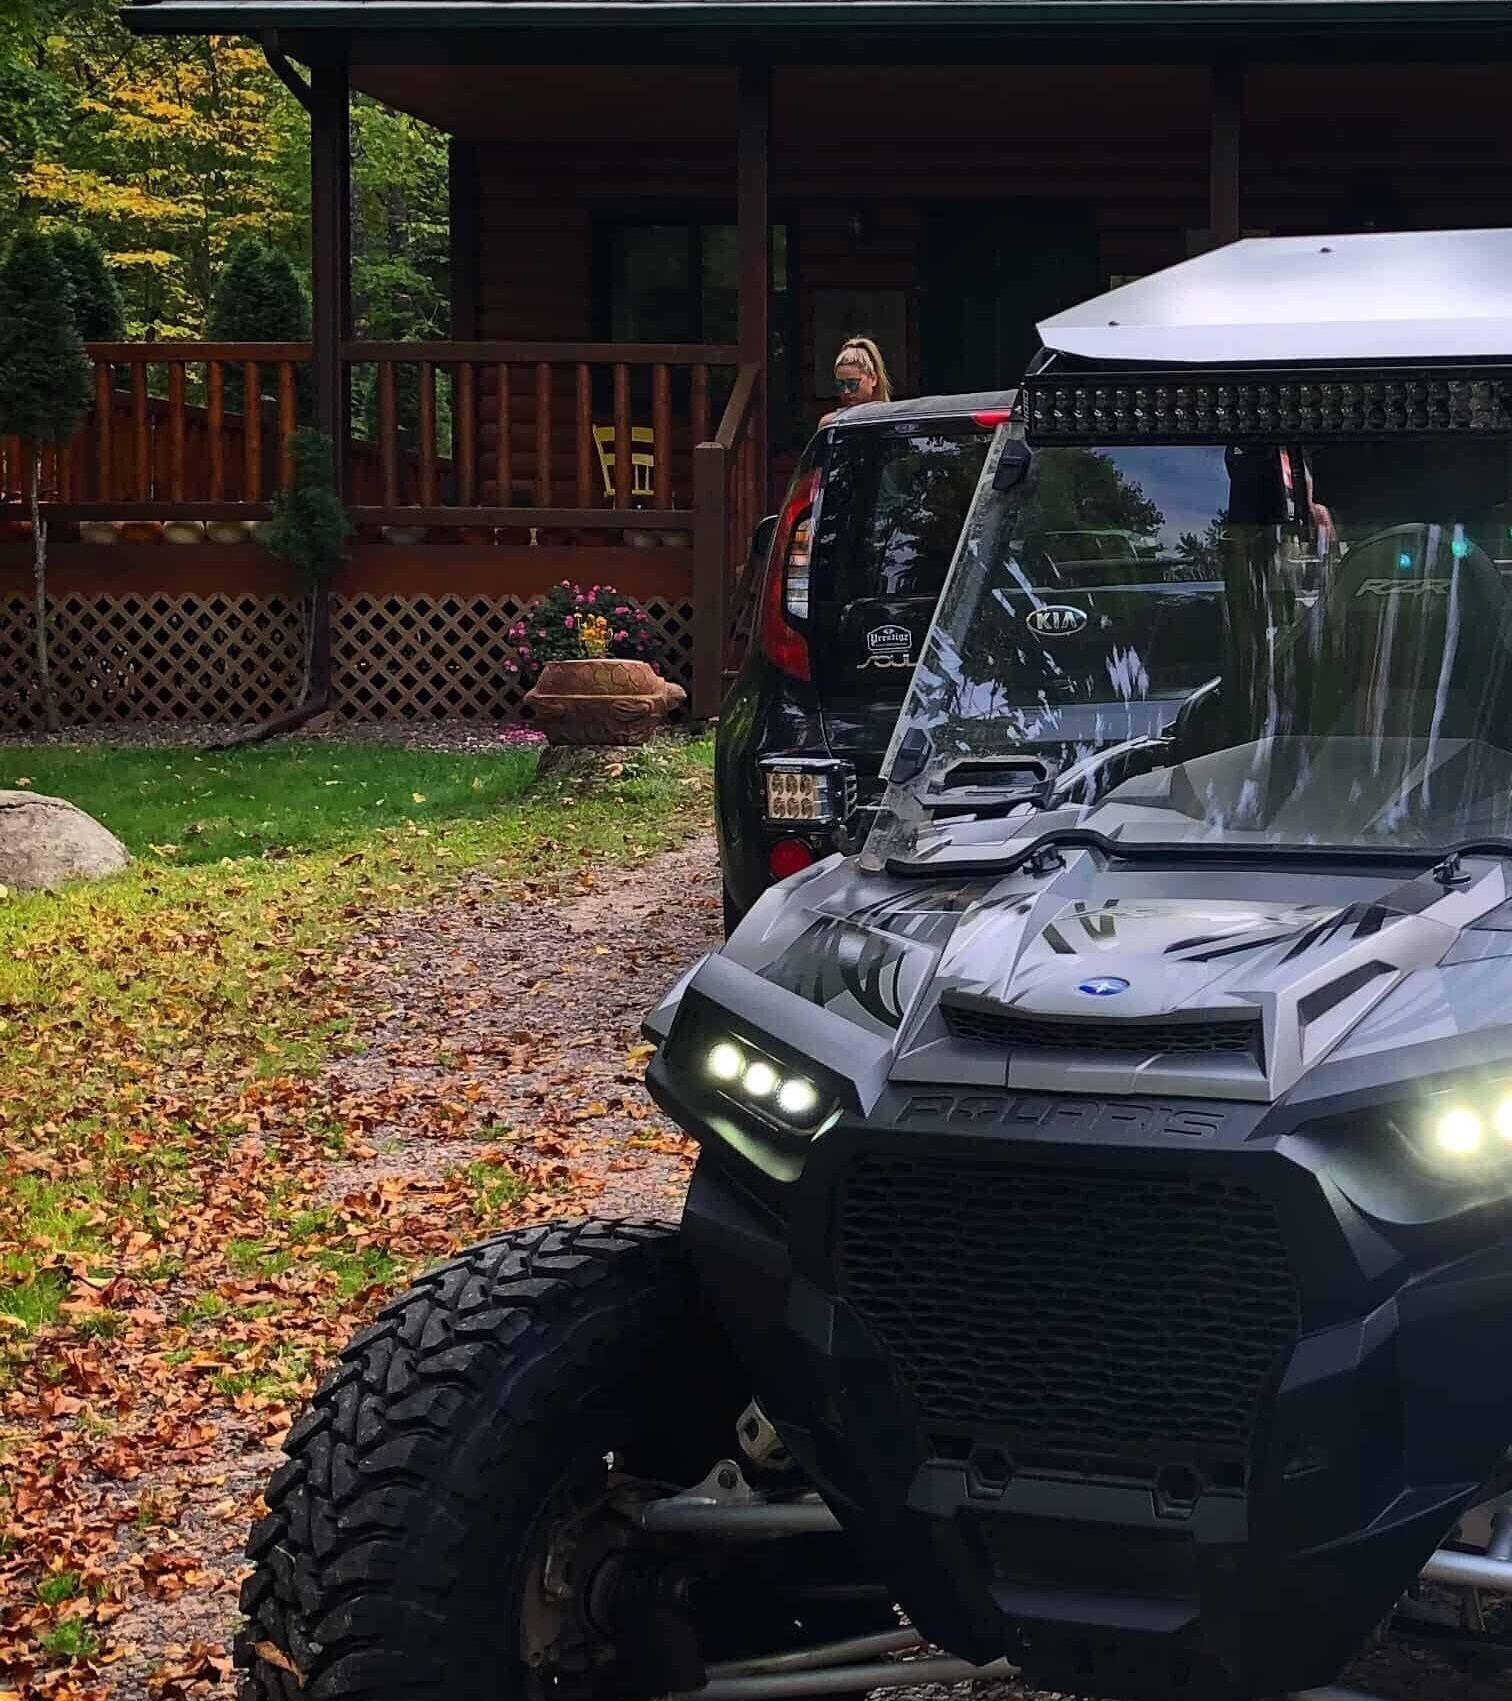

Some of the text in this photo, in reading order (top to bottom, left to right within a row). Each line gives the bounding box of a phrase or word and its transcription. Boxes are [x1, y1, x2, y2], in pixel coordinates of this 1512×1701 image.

[1036, 611, 1078, 630] KIA
[856, 653, 920, 669] SOUL
[893, 1095, 1226, 1138] POLARIS
